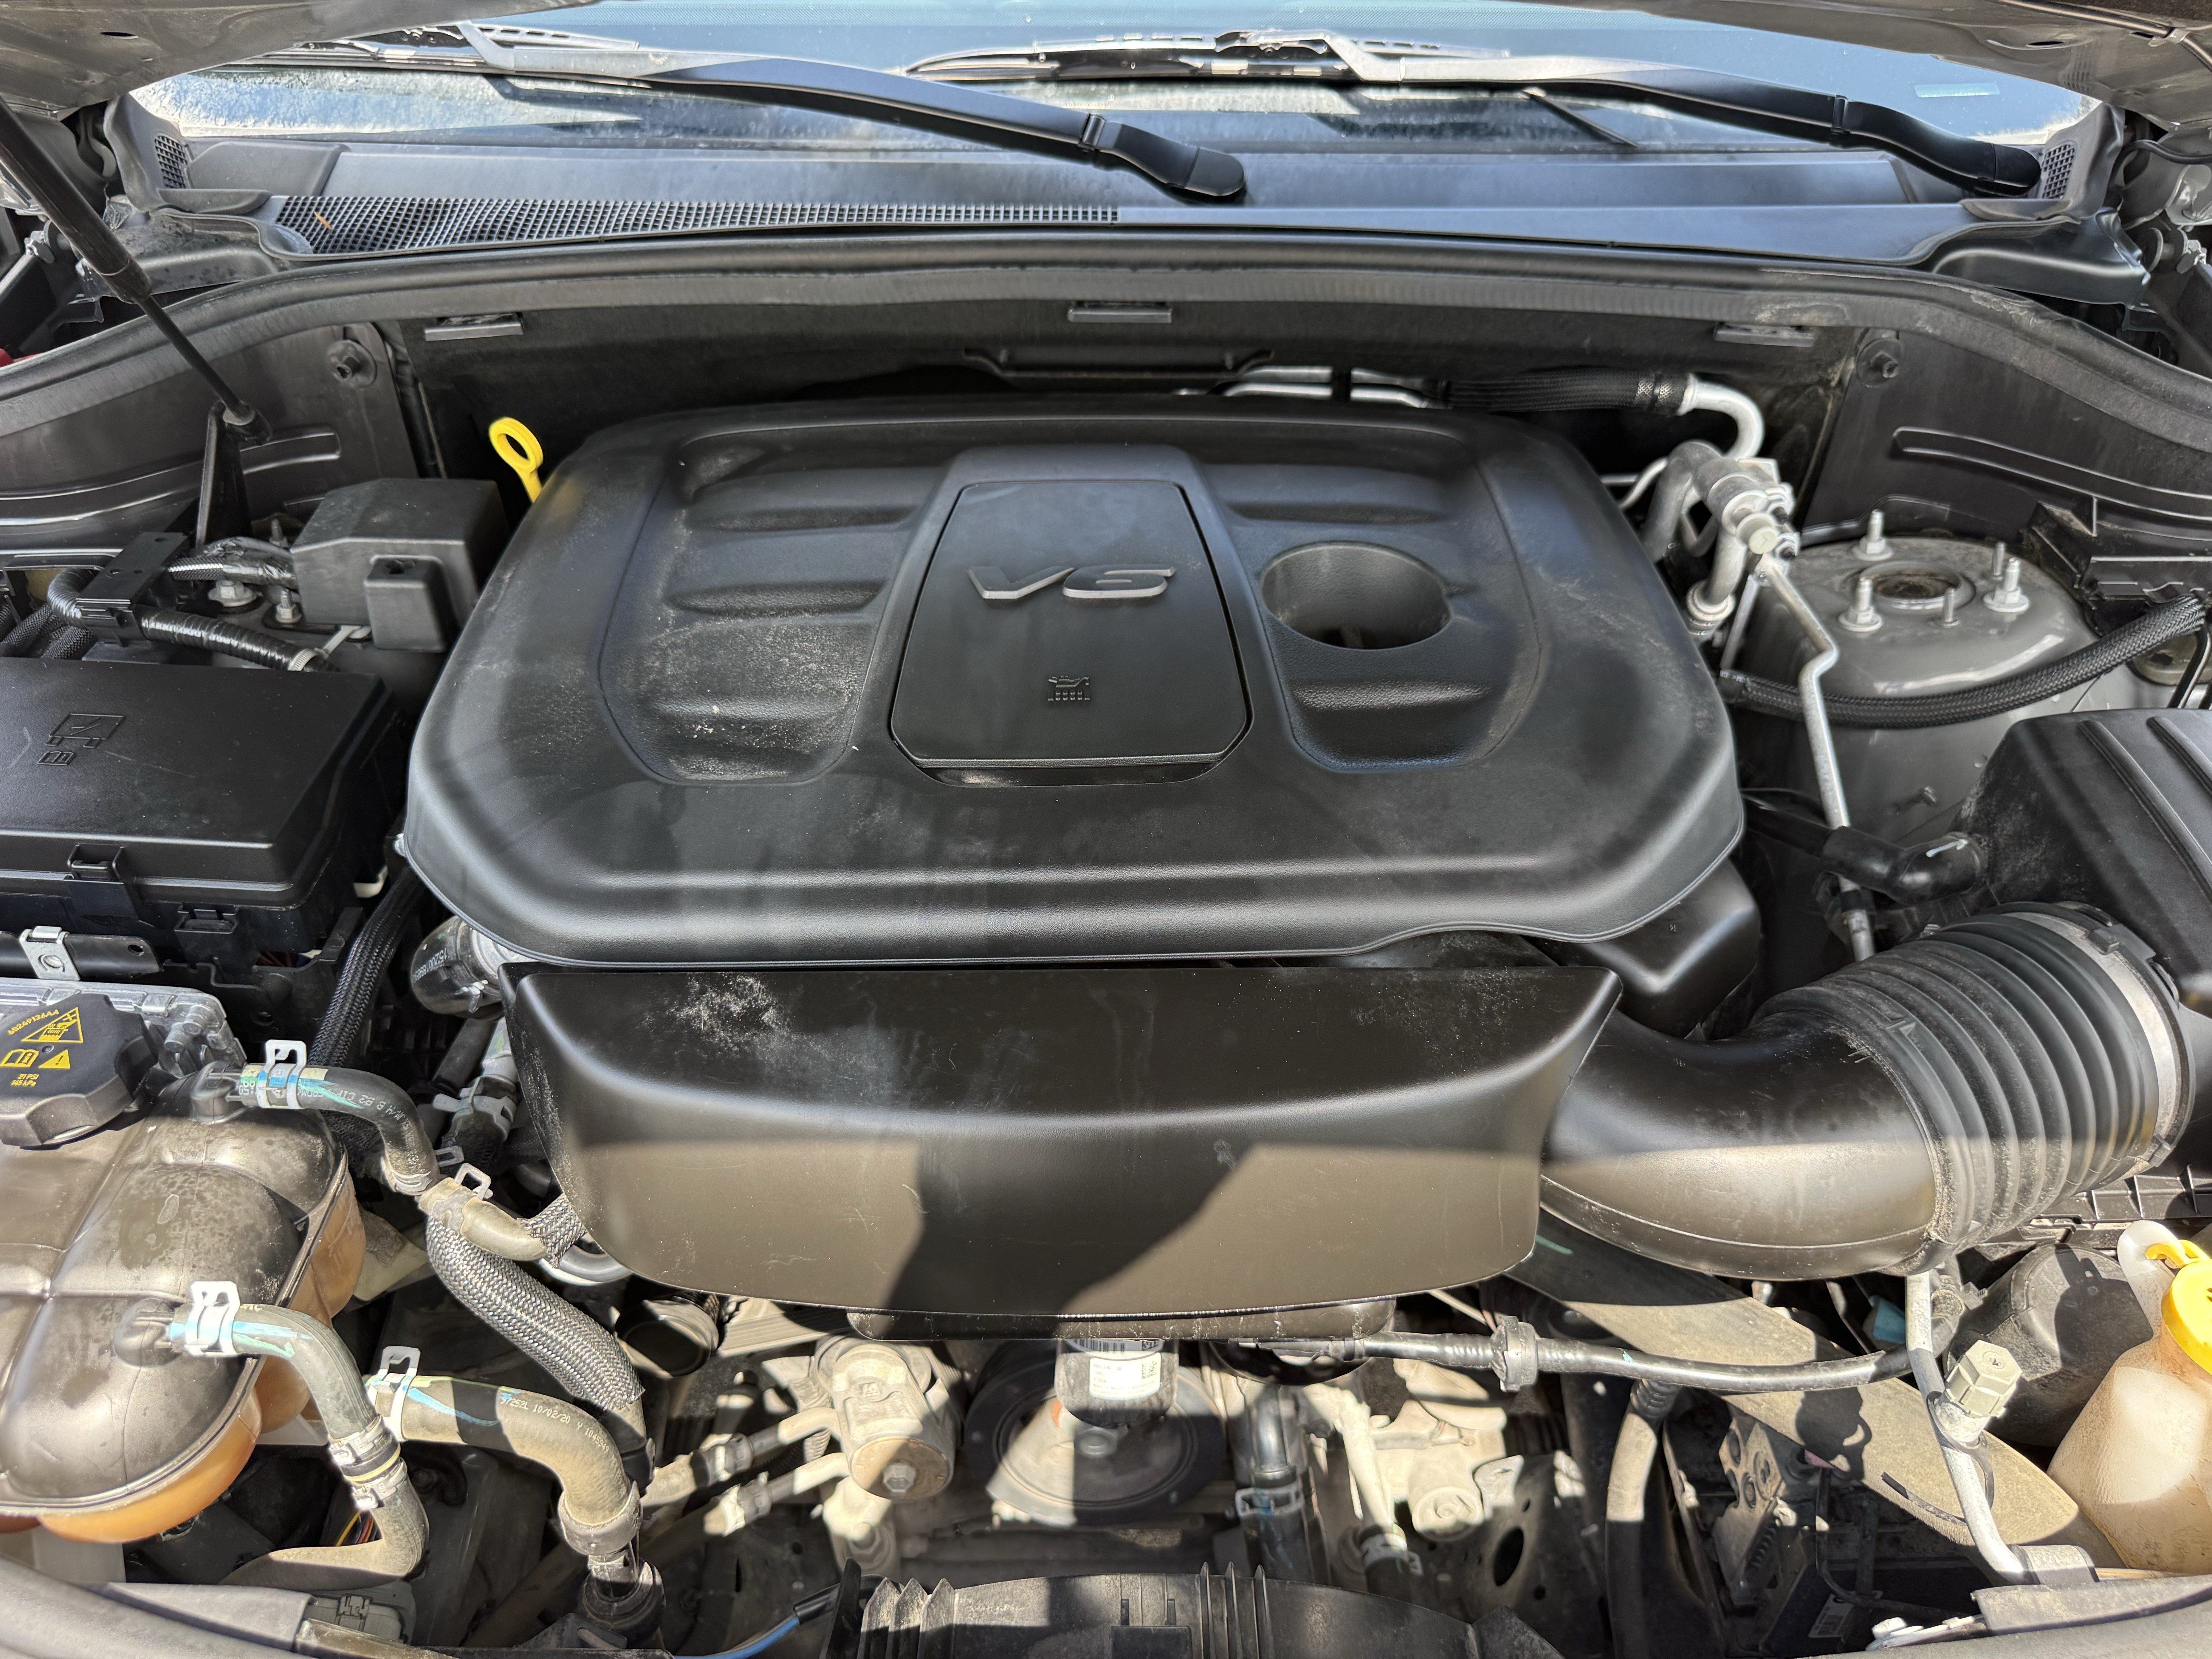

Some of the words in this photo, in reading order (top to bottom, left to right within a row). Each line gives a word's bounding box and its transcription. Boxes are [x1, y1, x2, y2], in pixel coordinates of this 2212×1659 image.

[966, 564, 1176, 600] V6
[533, 1404, 571, 1424] 10/02/20
[585, 1427, 610, 1453] 1045949
